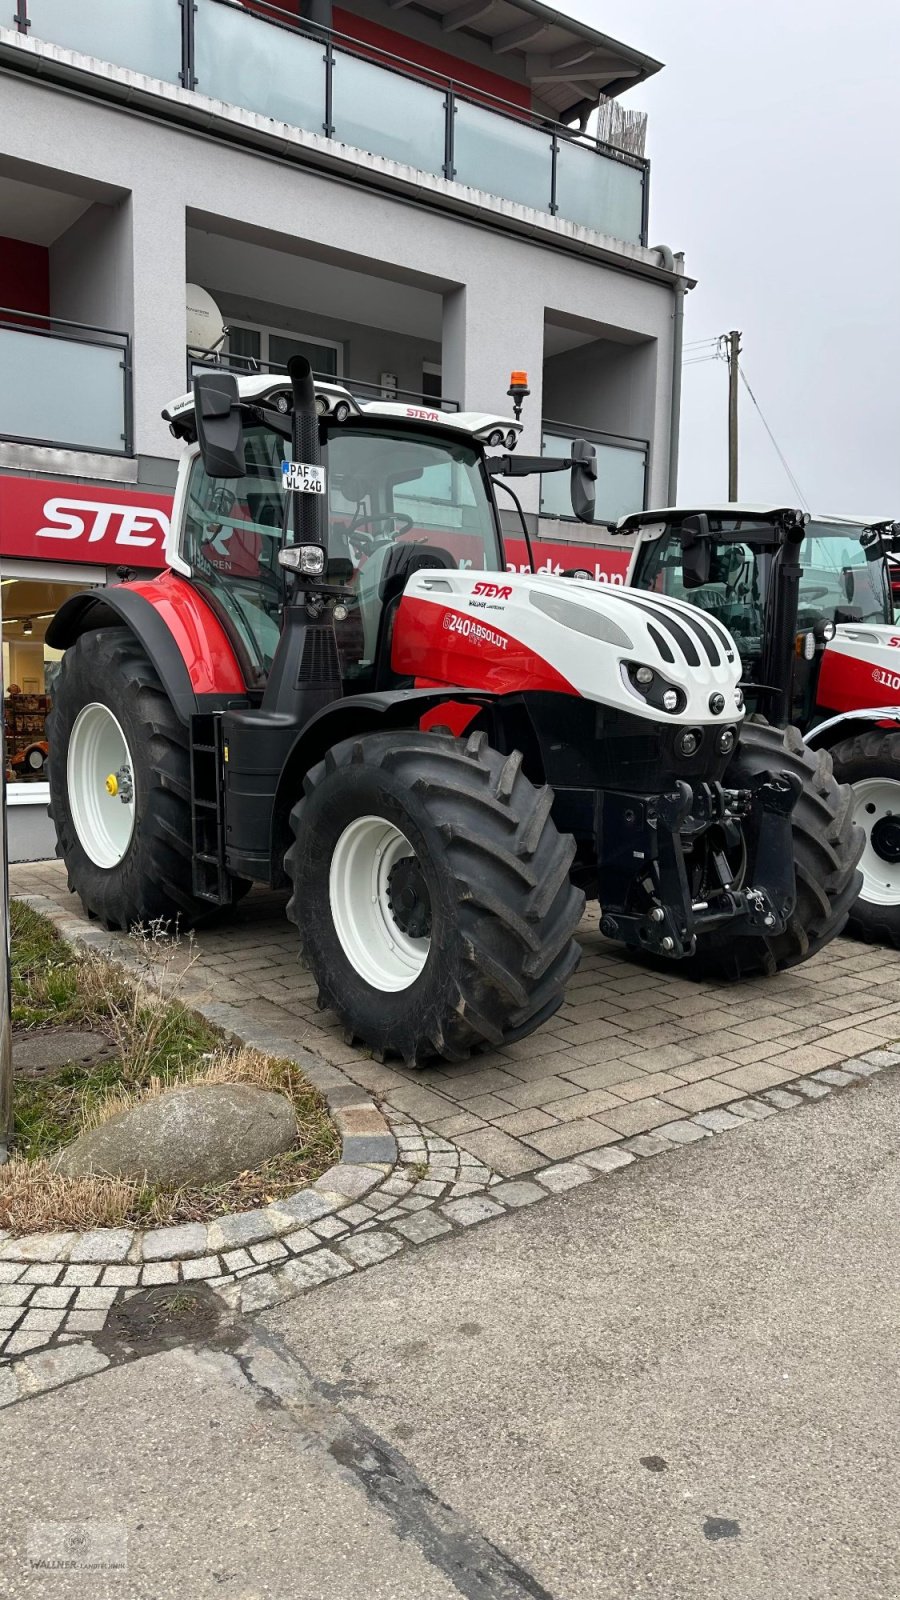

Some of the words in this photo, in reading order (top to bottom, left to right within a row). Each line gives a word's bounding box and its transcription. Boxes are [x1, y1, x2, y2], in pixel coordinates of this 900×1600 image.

[406, 408, 439, 421] STEYR
[290, 465, 310, 477] PAF
[286, 477, 300, 489] WL
[303, 479, 322, 492] 240
[471, 582, 513, 600] STEYR
[443, 612, 471, 636] 6240
[470, 623, 508, 650] ABSOLUT
